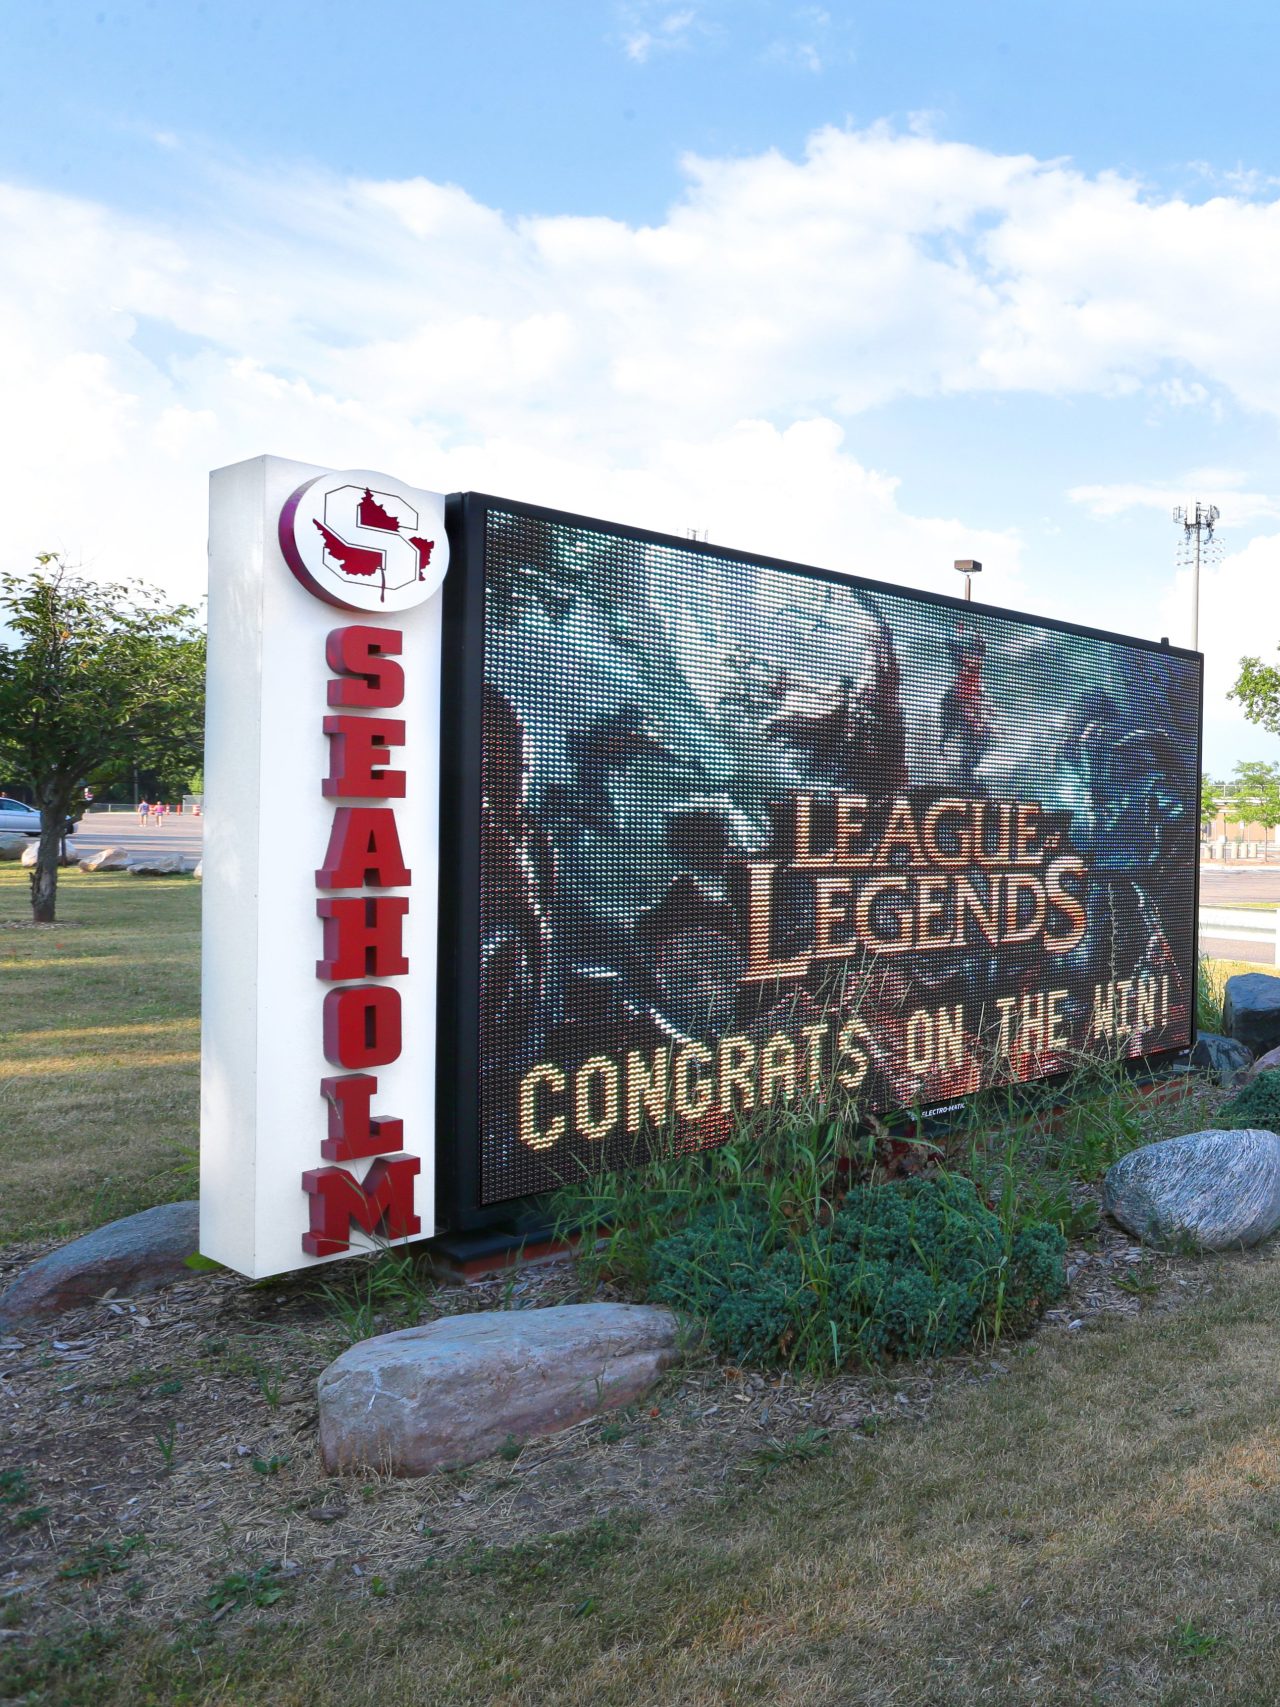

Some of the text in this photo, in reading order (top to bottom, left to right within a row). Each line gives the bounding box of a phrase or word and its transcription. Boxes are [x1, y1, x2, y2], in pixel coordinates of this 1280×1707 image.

[790, 794, 1043, 868] LEAGUE
[301, 625, 421, 1258] SEAHOLM
[740, 855, 1088, 983] LEGENDS
[519, 1017, 871, 1151] CONGRATS
[906, 1003, 964, 1075] ON
[996, 989, 1069, 1058] THE
[921, 1102, 966, 1117] ELECTRO-MATIC
